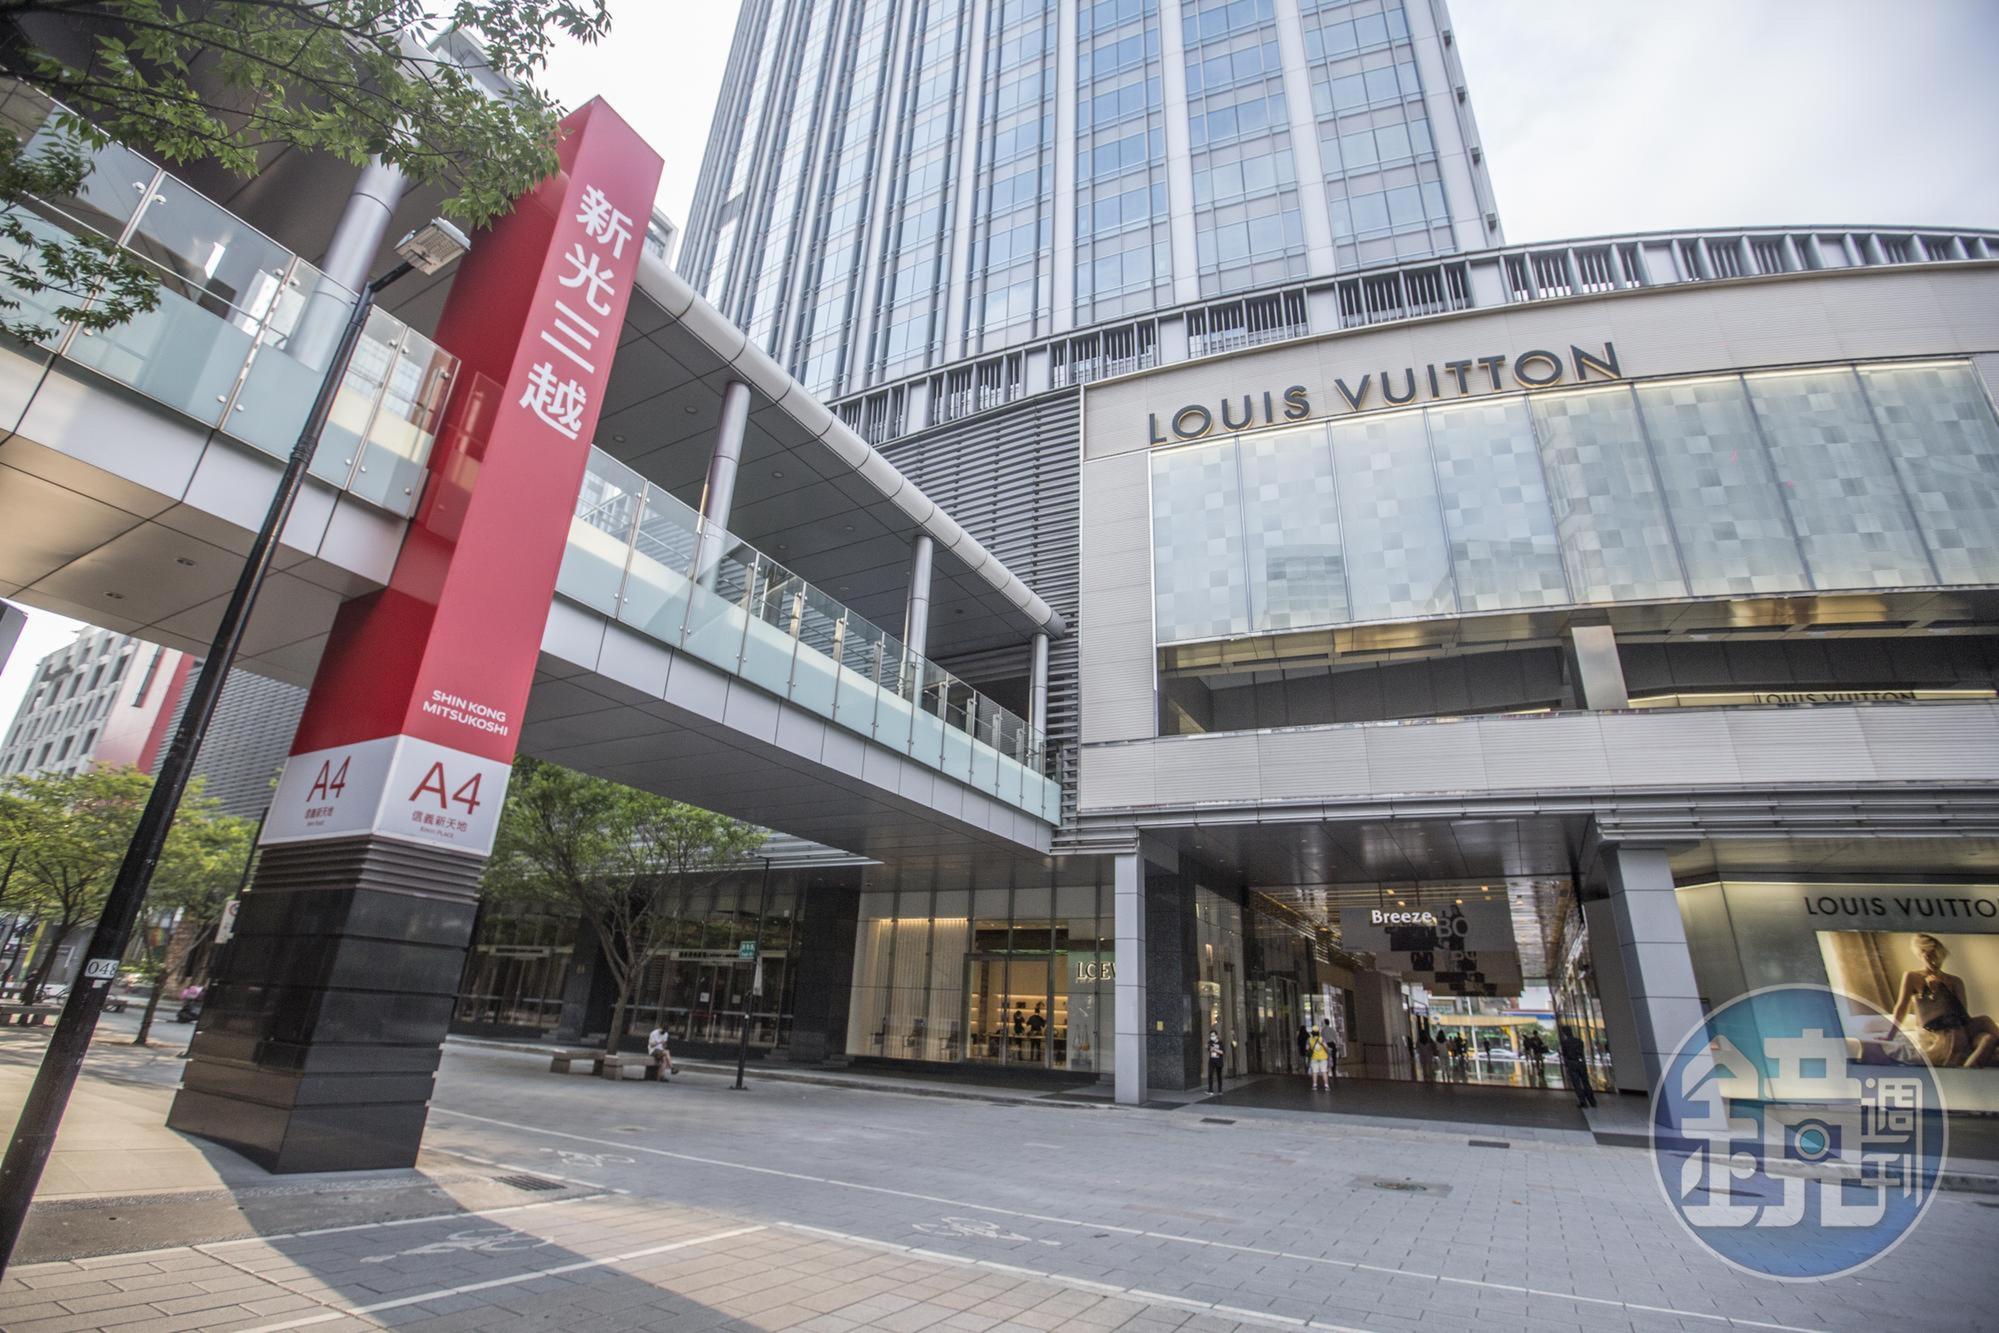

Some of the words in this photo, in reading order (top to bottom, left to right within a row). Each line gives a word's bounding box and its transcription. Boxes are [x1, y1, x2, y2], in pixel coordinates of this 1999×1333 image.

[519, 184, 633, 440] 新光三越
[1149, 385, 1310, 446] LOUIS
[1334, 342, 1621, 412] VUITTON
[423, 700, 508, 737] MITSUKOSHI
[432, 689, 467, 710] SHIN
[468, 701, 507, 723] KONG
[306, 755, 352, 802] A4
[408, 761, 482, 815] A4
[1371, 909, 1432, 924] Breeze
[1804, 896, 1886, 916] LOUIS
[1894, 899, 1999, 918] VUITTO
